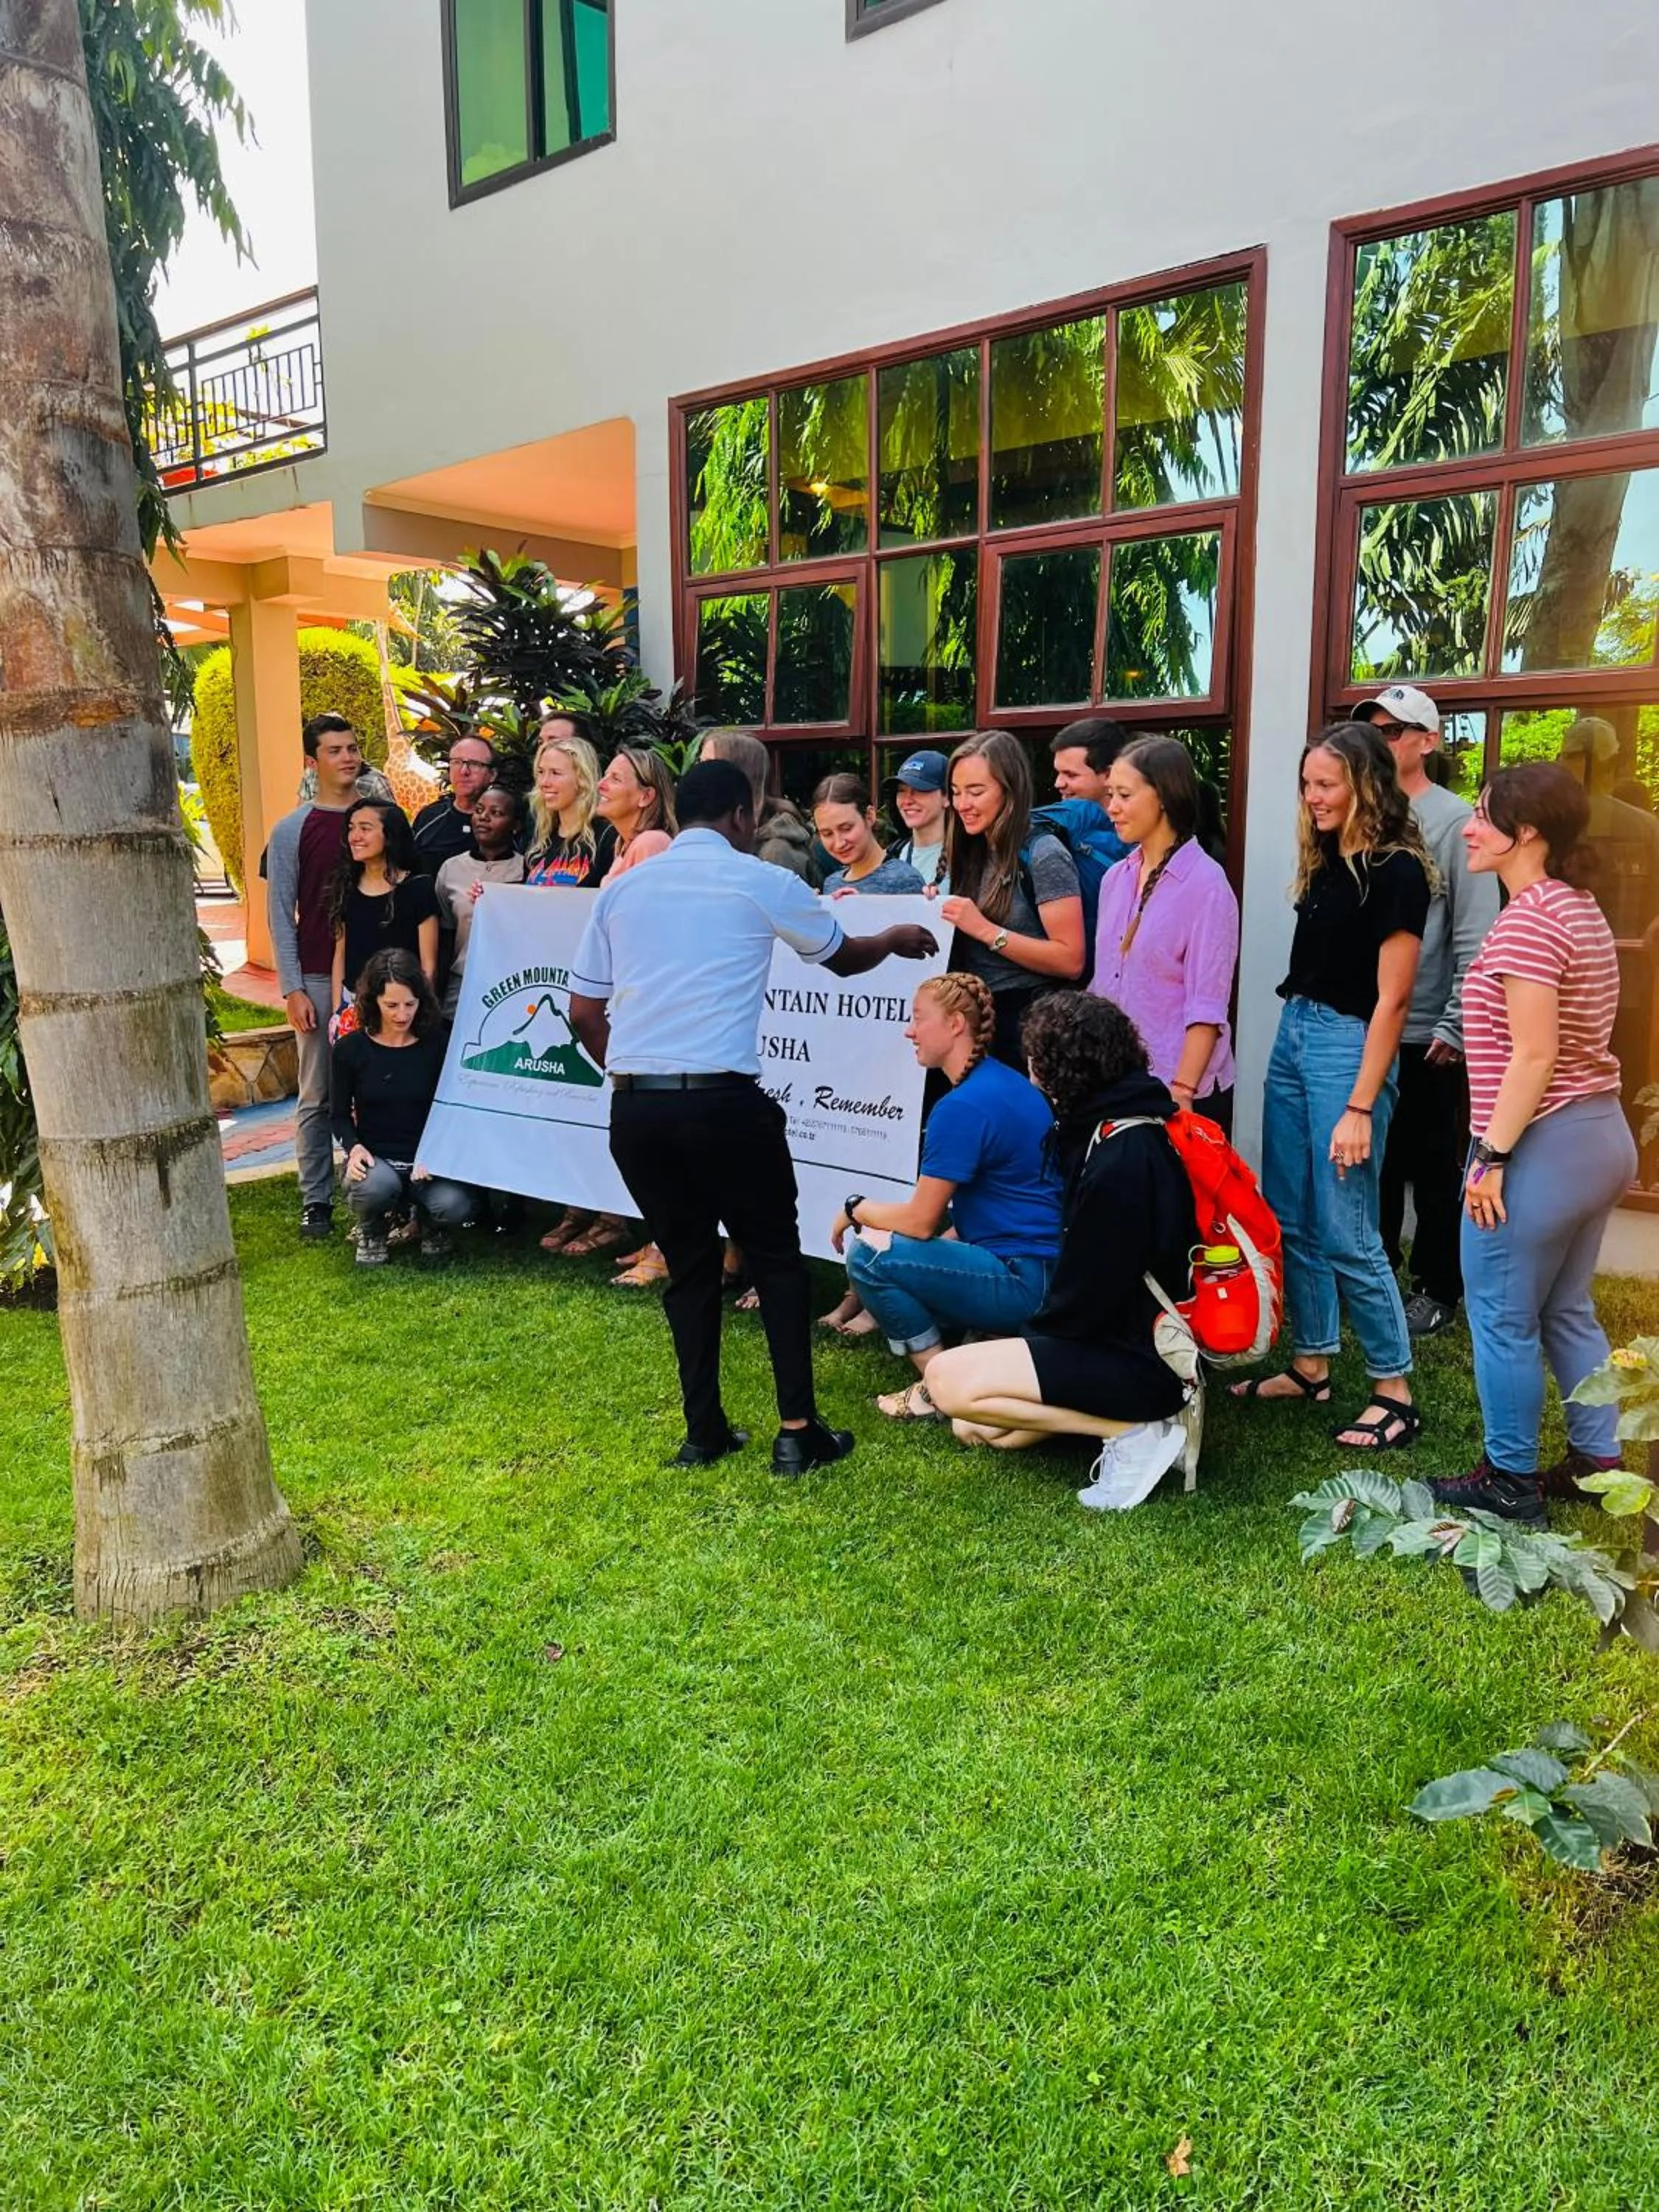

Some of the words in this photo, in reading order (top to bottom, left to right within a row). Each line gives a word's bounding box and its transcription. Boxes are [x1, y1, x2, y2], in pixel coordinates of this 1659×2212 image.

[481, 973, 521, 1009] GREEN
[837, 993, 911, 1023] HOTEL
[514, 1057, 566, 1076] ARUSHA
[813, 1085, 905, 1121] Remember
